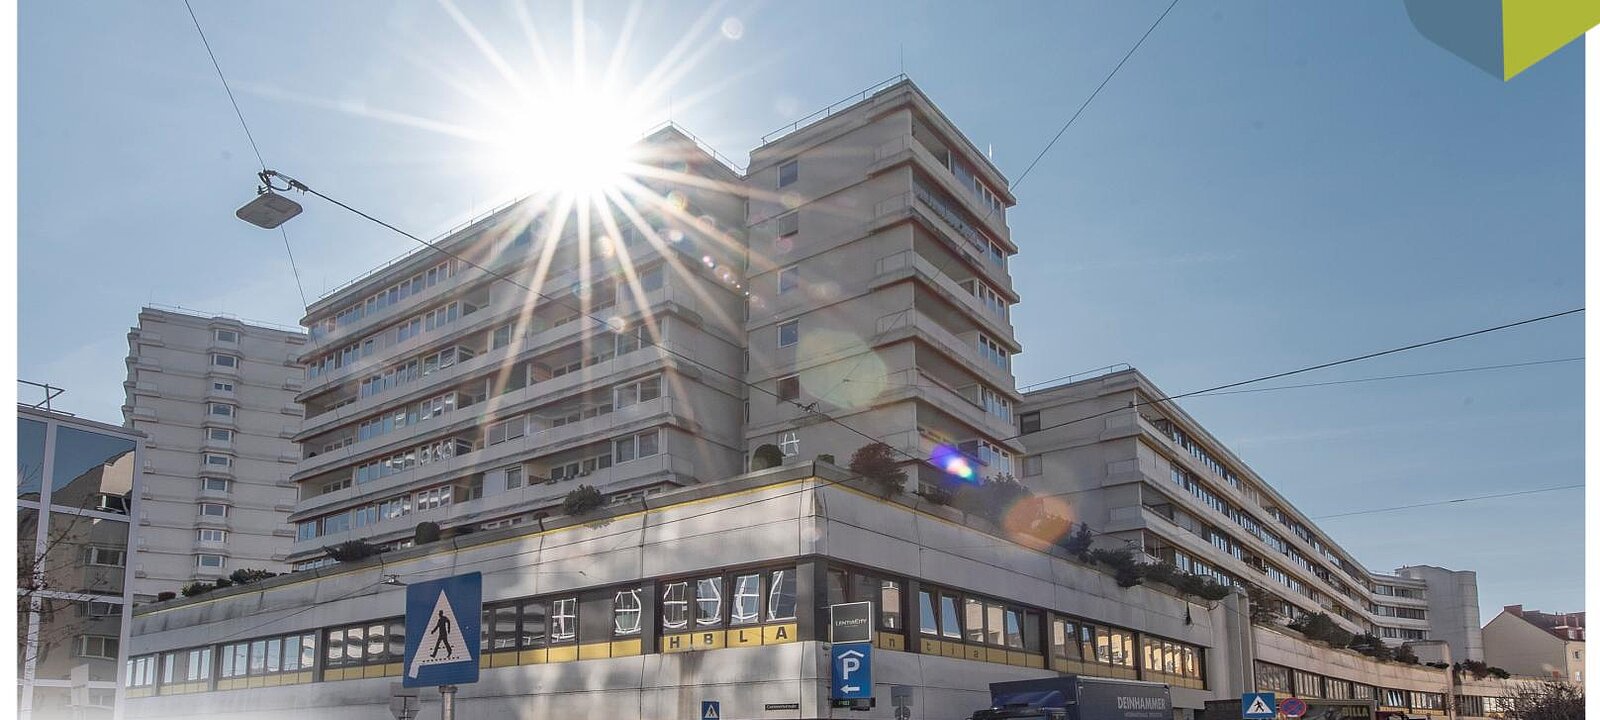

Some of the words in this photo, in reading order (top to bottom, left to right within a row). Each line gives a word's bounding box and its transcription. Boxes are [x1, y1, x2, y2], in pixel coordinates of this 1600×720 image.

[843, 657, 860, 680] P
[1117, 696, 1165, 710] DEINHAMMER
[1342, 706, 1369, 717] BILLA
